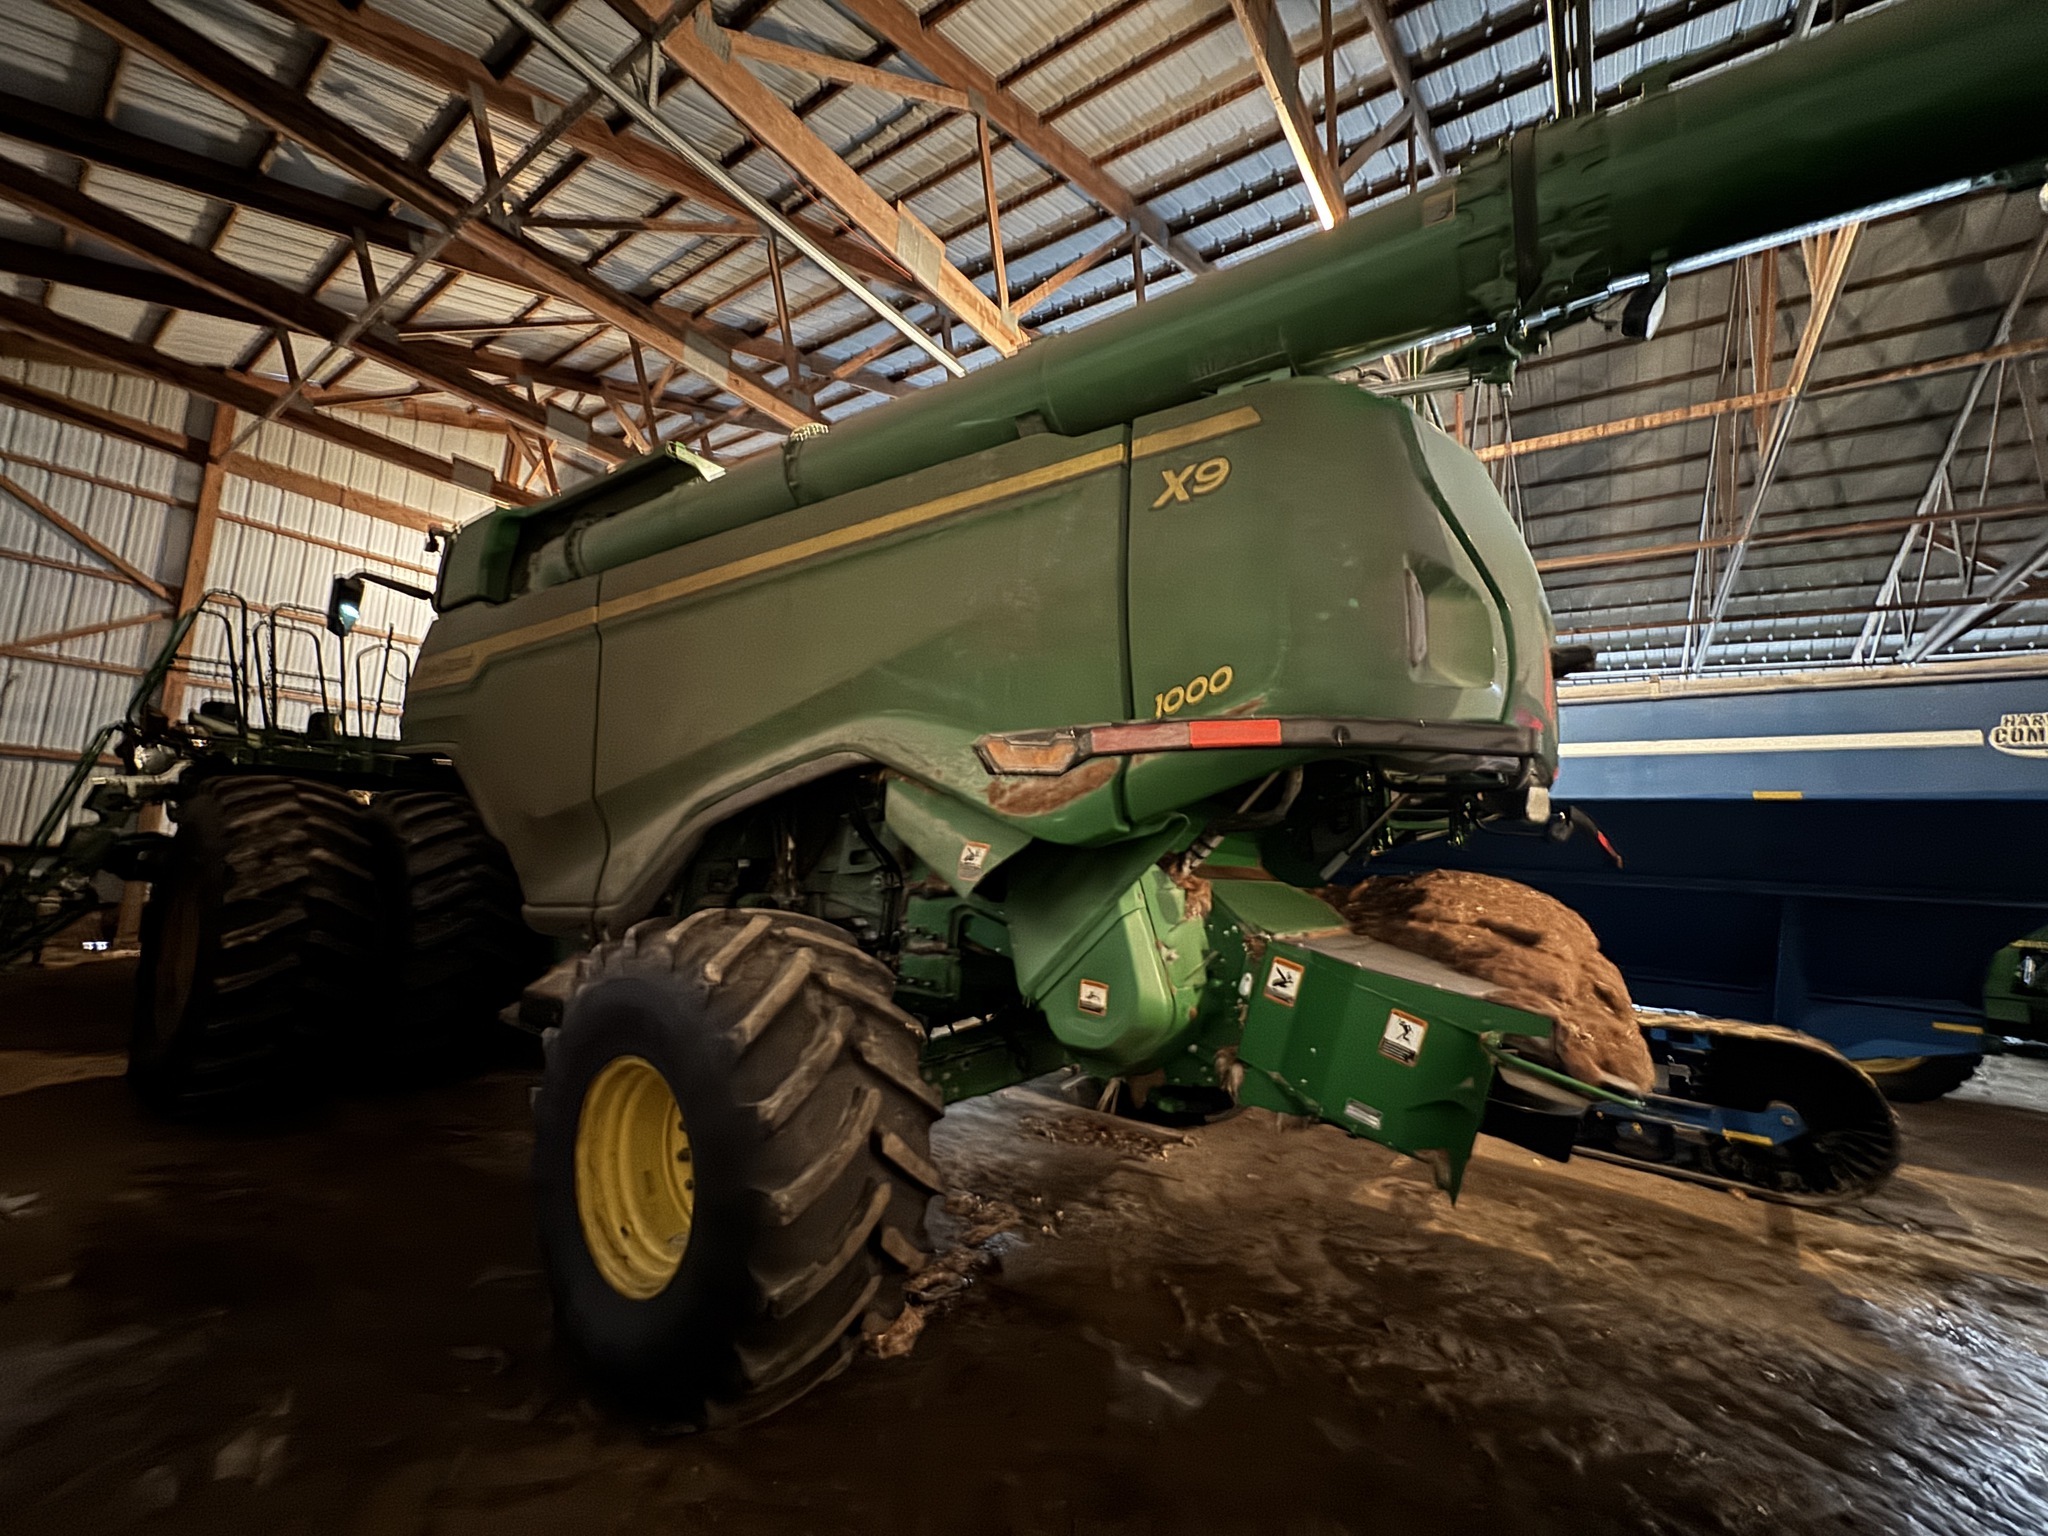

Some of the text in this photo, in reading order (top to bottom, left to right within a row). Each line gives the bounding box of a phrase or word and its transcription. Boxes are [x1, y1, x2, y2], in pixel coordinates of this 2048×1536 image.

[1151, 456, 1231, 508] X9
[1154, 664, 1234, 720] 1000
[2003, 713, 2048, 727] HAR
